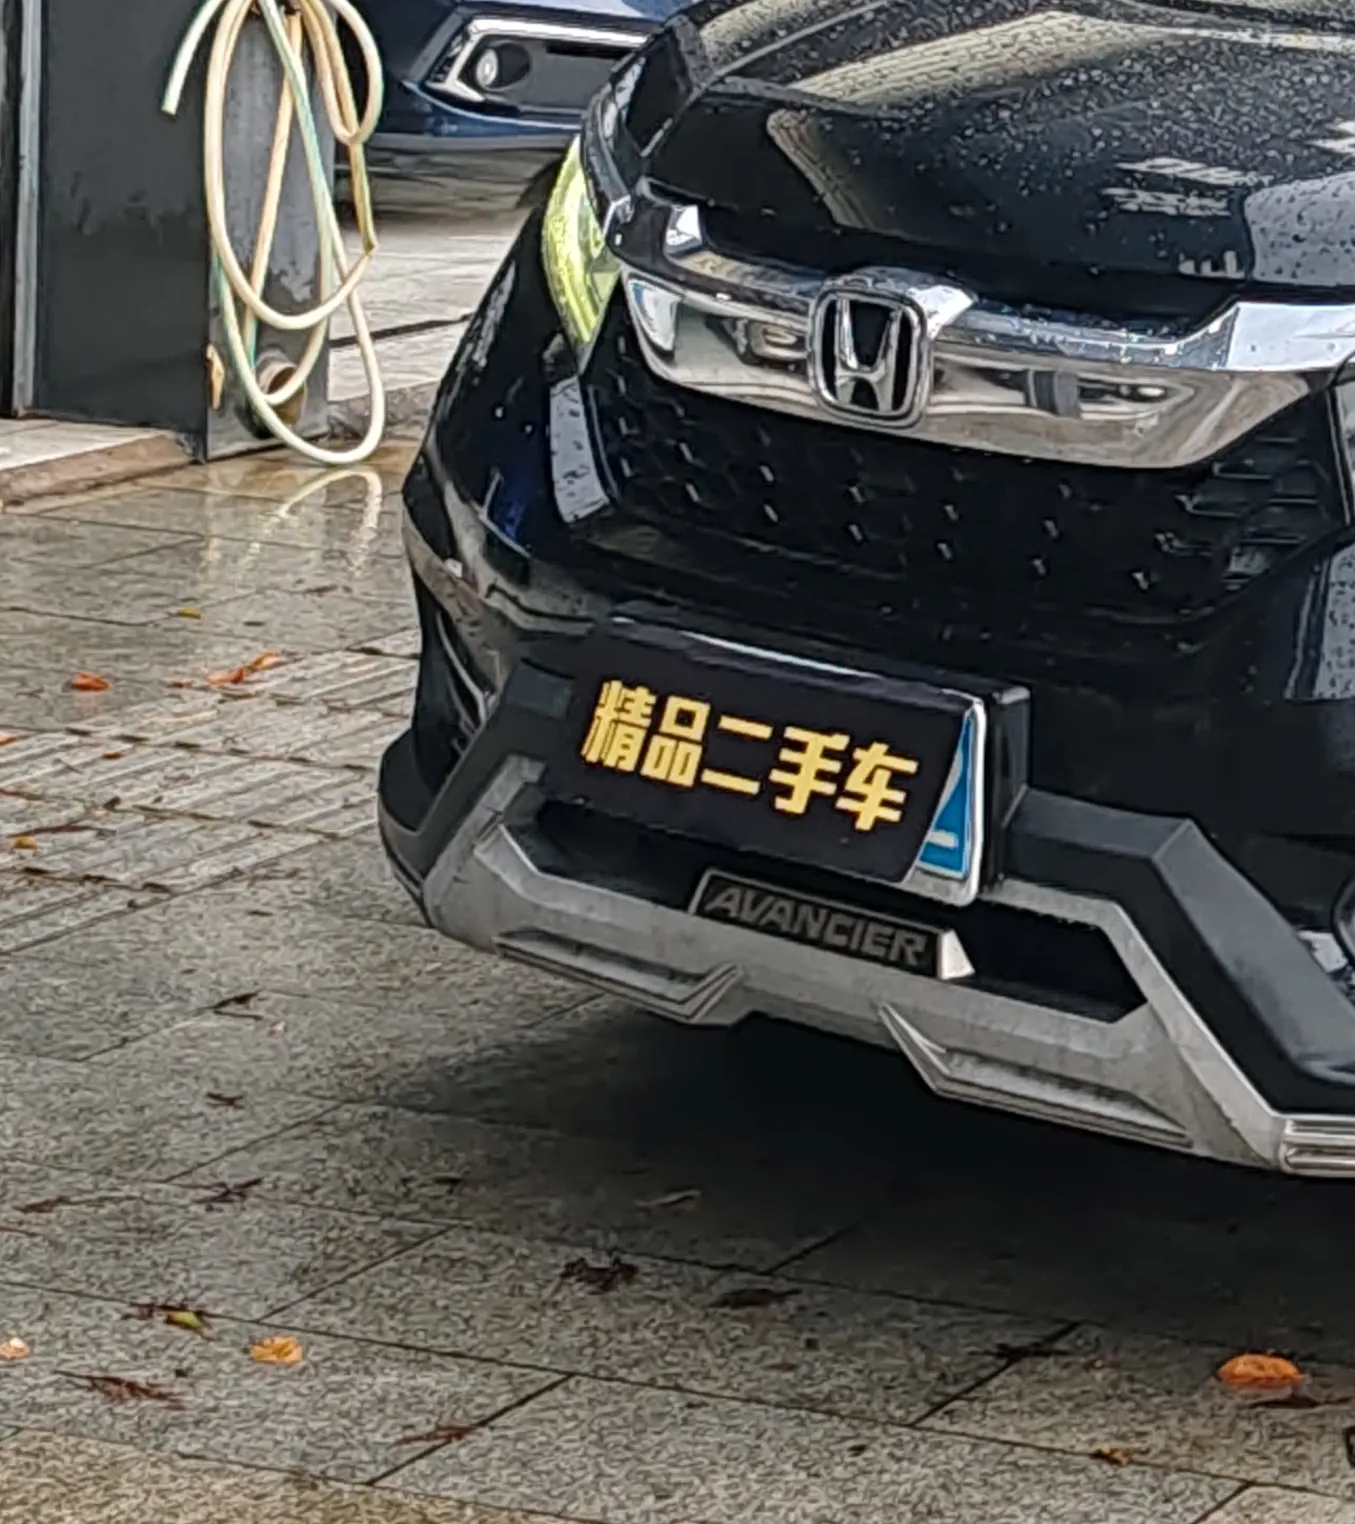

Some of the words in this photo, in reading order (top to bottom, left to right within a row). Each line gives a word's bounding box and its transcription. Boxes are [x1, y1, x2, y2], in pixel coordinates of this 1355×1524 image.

[580, 679, 918, 832] 精品二手车
[704, 885, 927, 967] AVANCIER
